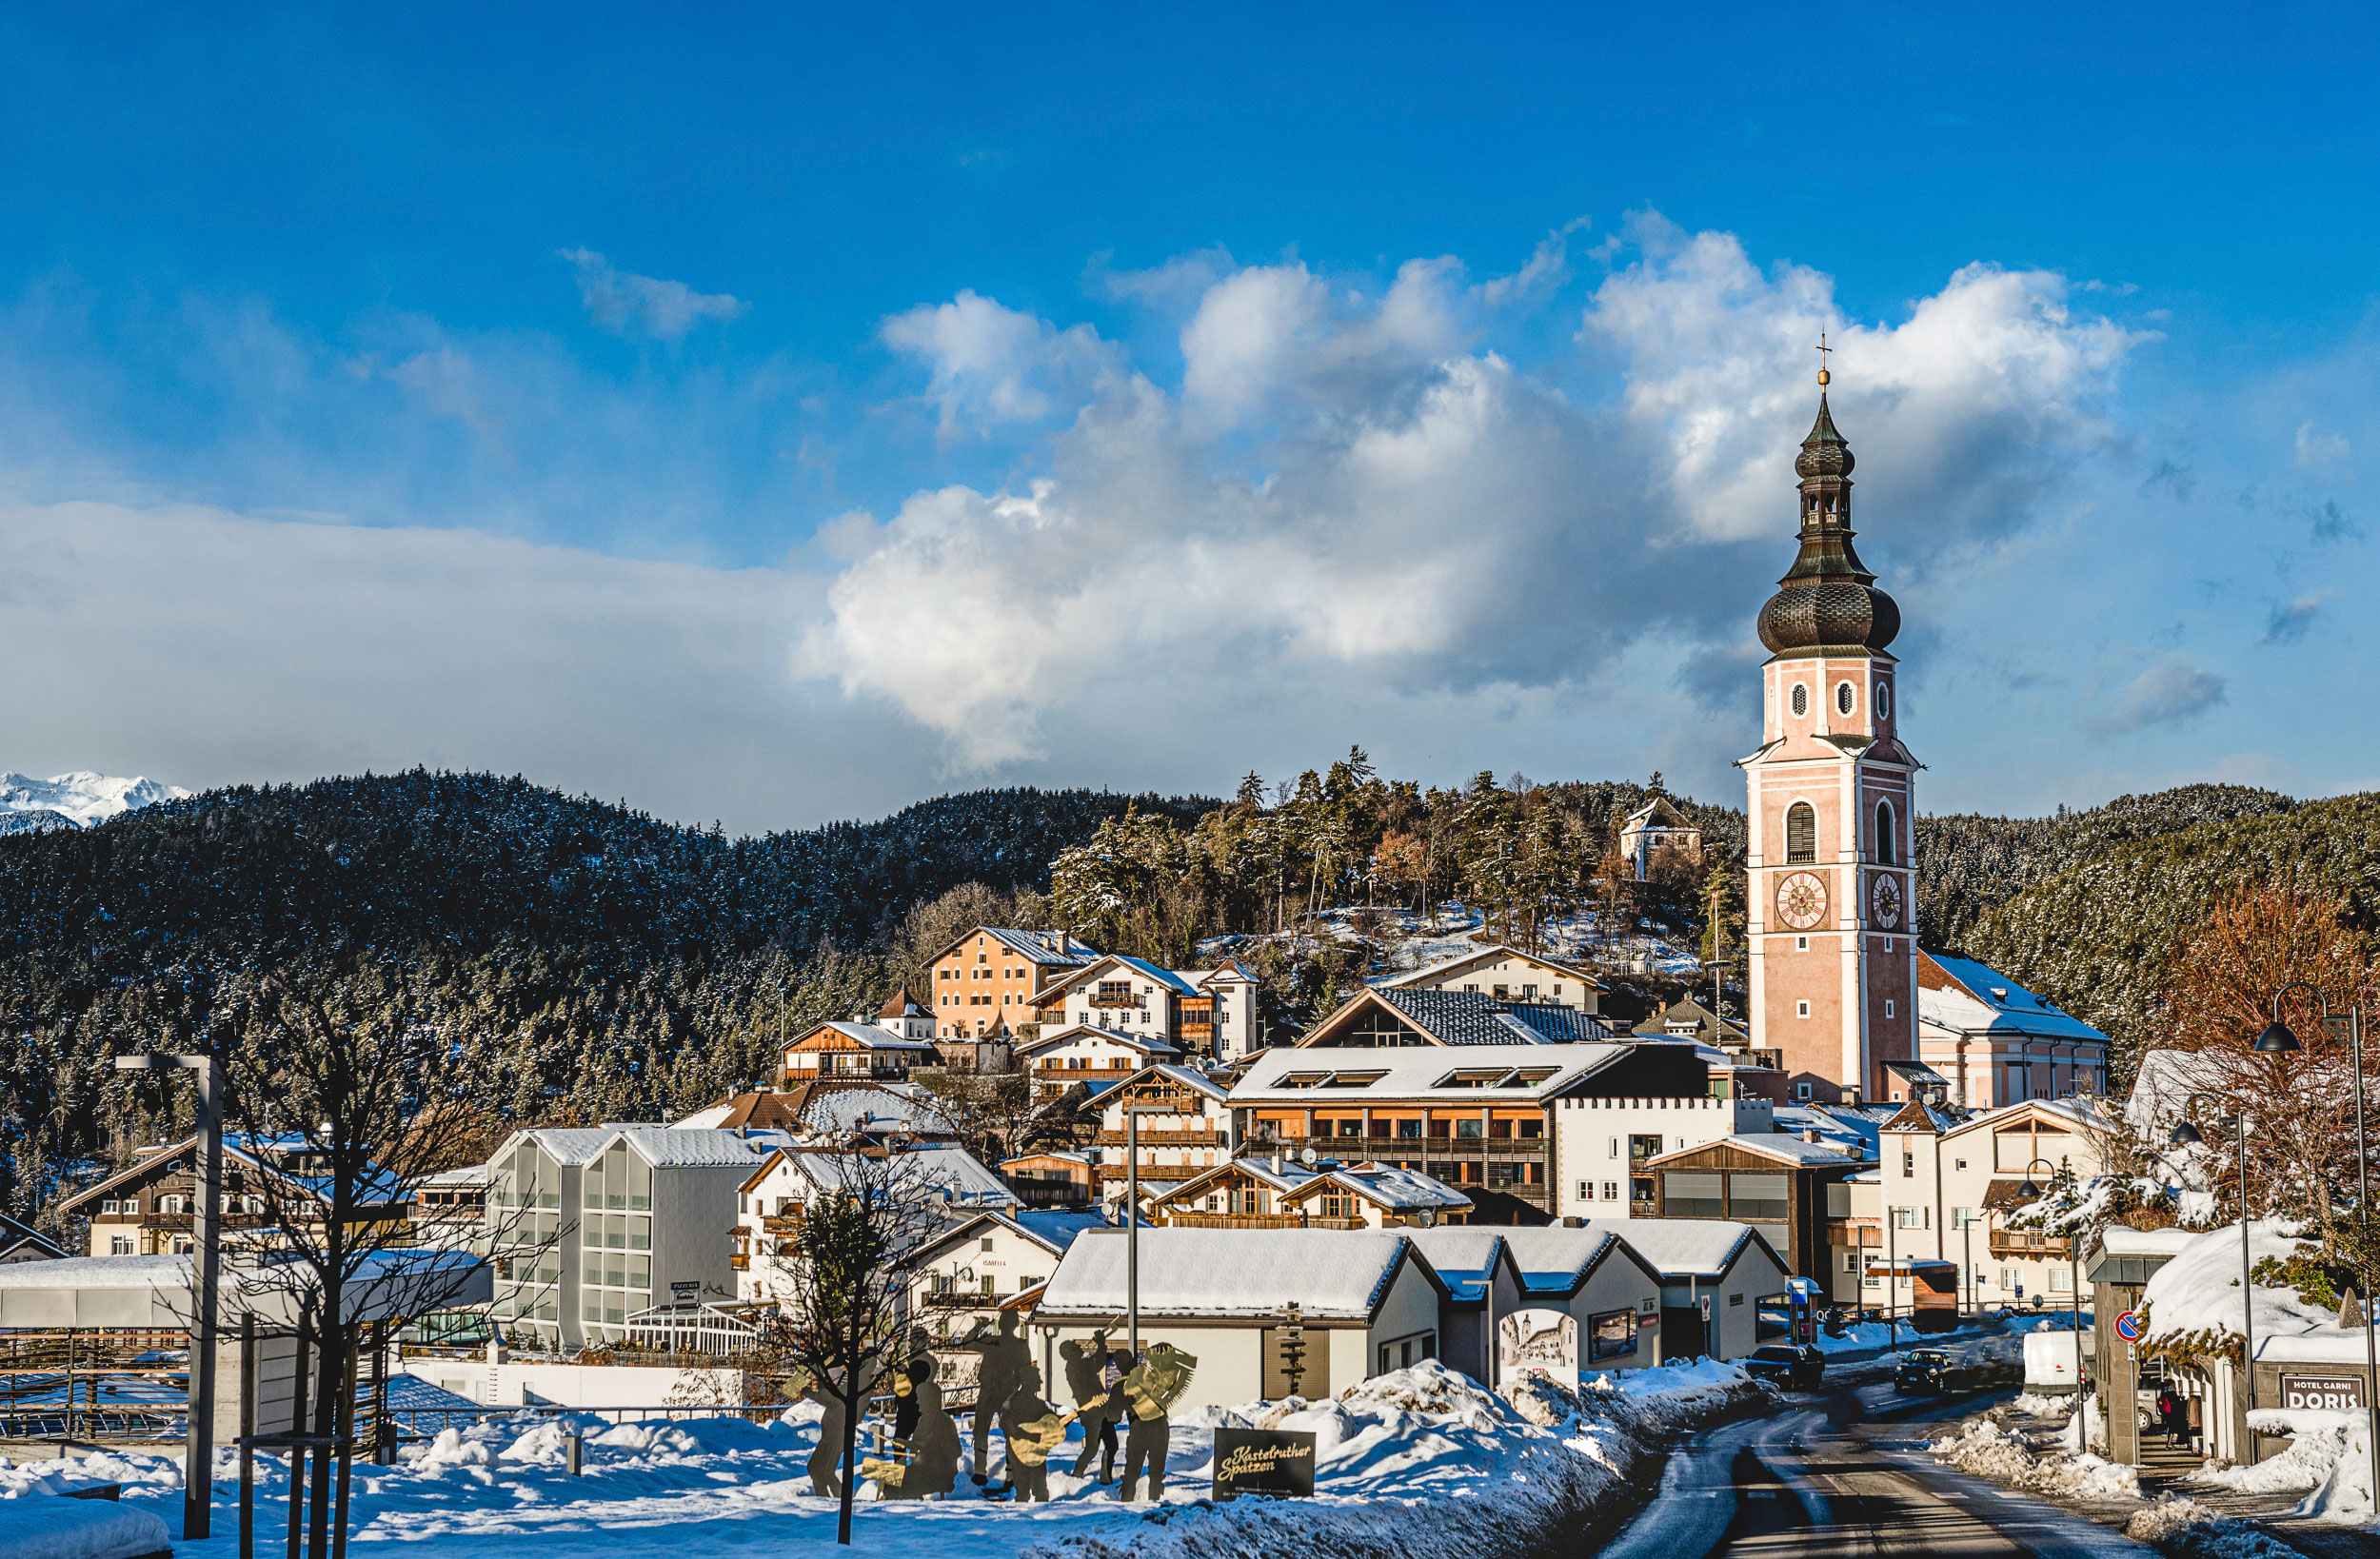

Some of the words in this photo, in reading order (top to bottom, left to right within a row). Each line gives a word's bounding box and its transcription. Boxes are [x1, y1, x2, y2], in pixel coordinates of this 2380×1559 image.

[2293, 1381, 2322, 1390] HOTEL
[2323, 1382, 2351, 1391] GARNI
[2289, 1391, 2358, 1409] DORIS
[1232, 1442, 1311, 1465] Kastelruther
[1217, 1457, 1275, 1482] Spatzen
